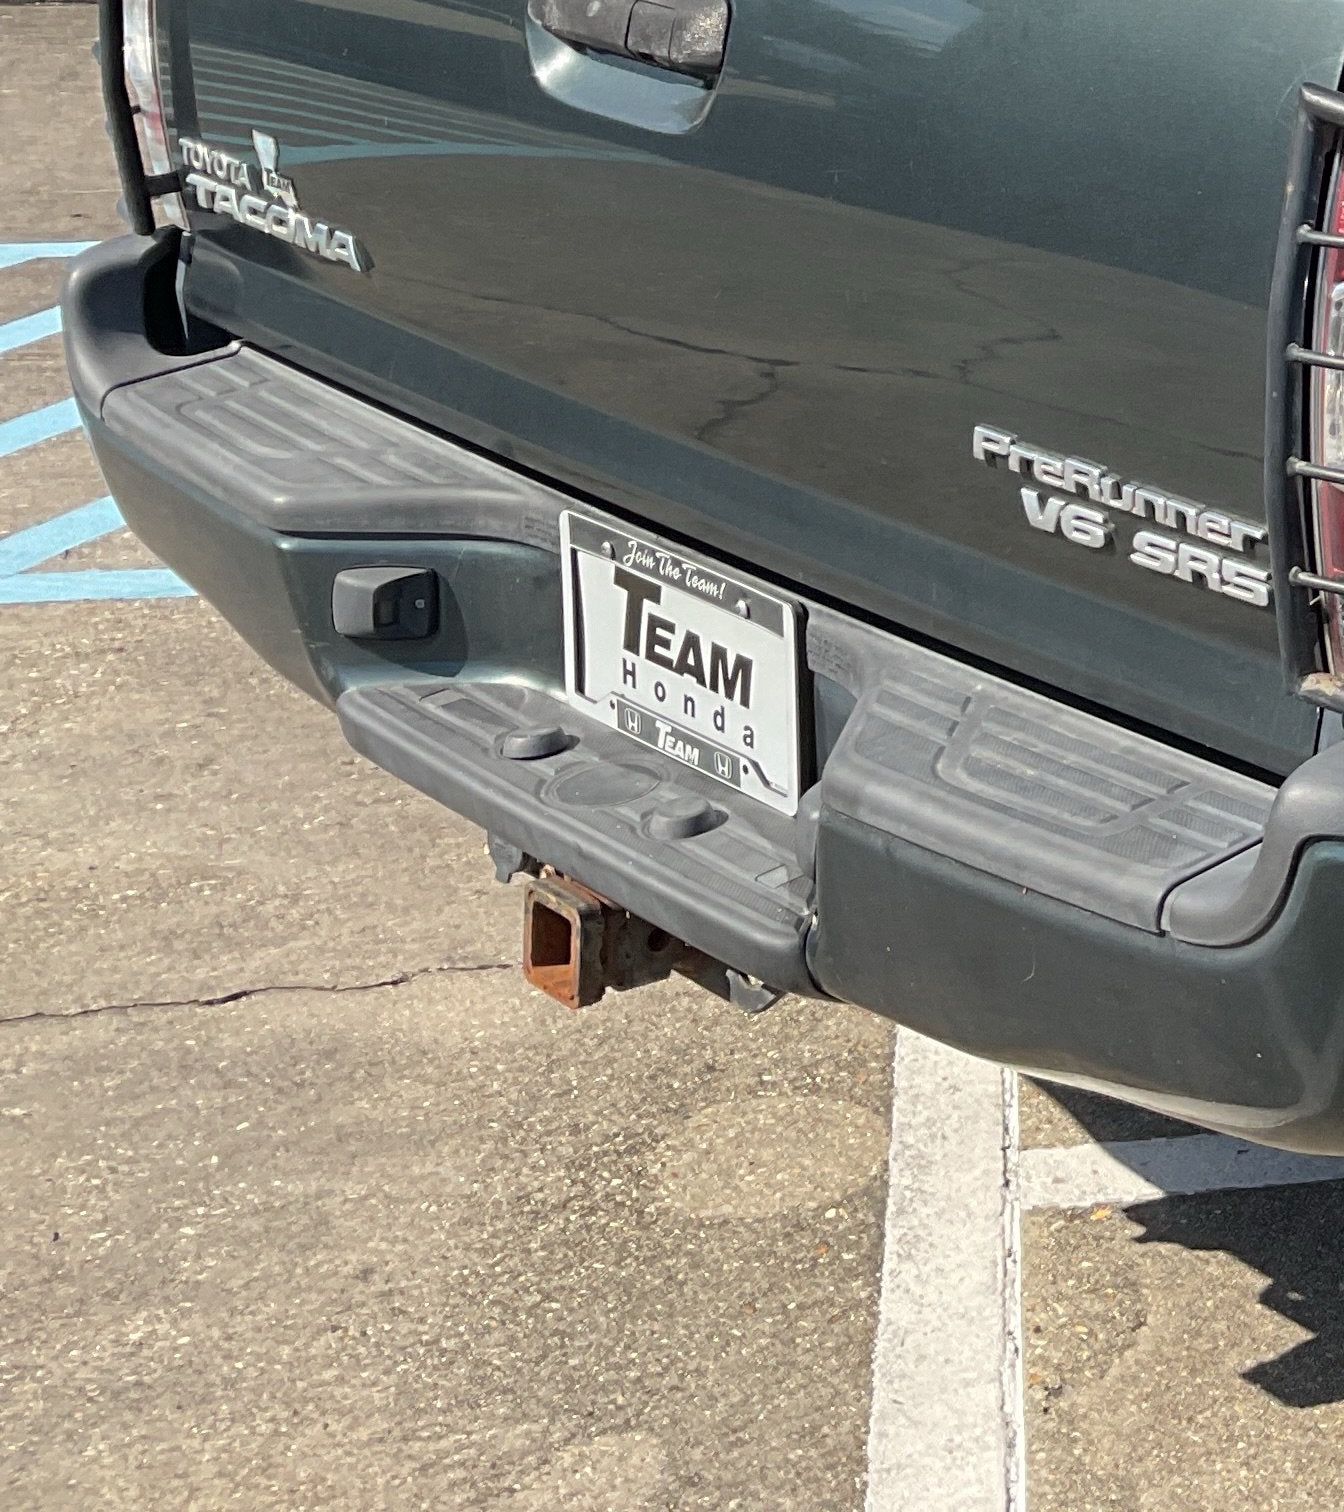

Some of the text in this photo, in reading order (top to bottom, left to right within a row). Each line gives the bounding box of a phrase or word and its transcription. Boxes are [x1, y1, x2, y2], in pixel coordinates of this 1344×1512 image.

[179, 138, 251, 191] TOYOTA
[186, 173, 362, 272] TACOMA
[1020, 486, 1108, 549] V6
[623, 541, 726, 600] Join The Team!
[1130, 530, 1273, 607] SR5
[613, 564, 754, 709] TEAM
[655, 720, 700, 766] TEAM
